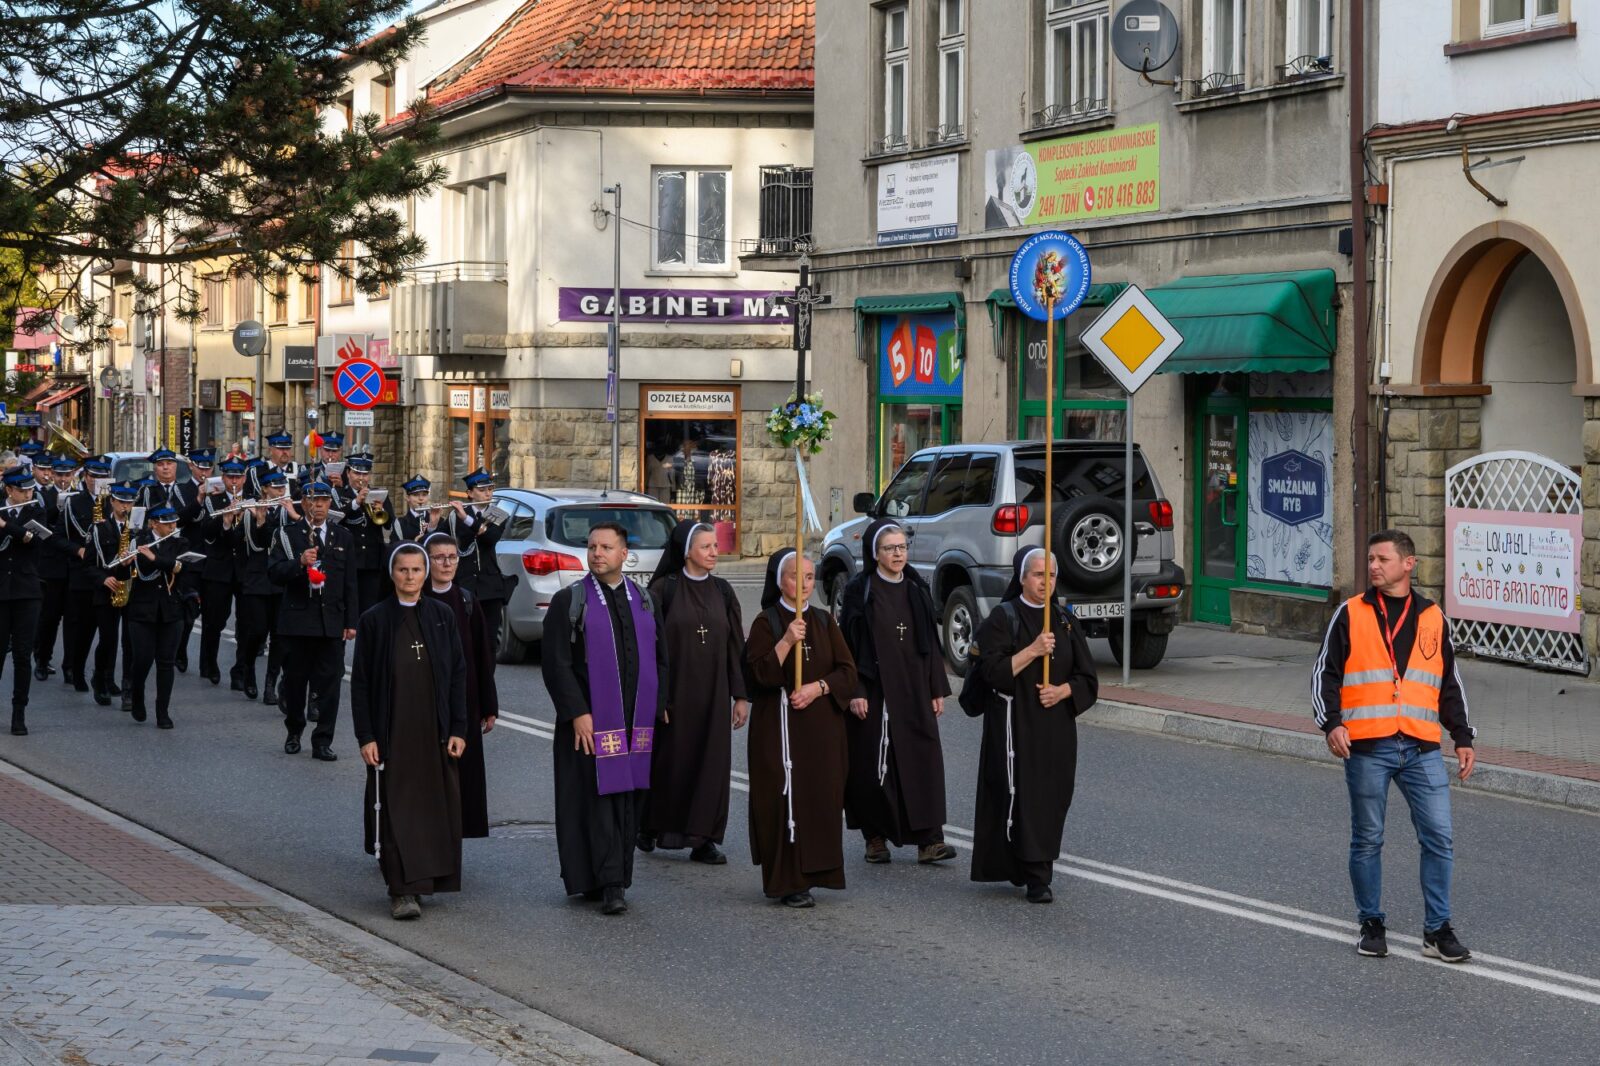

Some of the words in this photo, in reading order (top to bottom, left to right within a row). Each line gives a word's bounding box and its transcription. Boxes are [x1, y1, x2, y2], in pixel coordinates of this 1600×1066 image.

[1039, 141, 1083, 162] KOMPLEKSOWE
[1085, 138, 1107, 156] USŁUGI
[1108, 129, 1156, 152] KOMINIARSKIE
[1054, 163, 1078, 184] Sądecki
[1078, 159, 1099, 178] Zakład
[1100, 155, 1137, 175] Kominiarski
[1038, 196, 1055, 217] 24H
[1060, 192, 1080, 215] 7DNI
[1097, 186, 1113, 210] 518
[1116, 183, 1133, 207] 416
[1136, 179, 1156, 205] 883
[1040, 233, 1067, 242] MSZANY
[1067, 239, 1087, 263] DOLNEJ
[1012, 242, 1034, 290] PIELGRZYMKA
[1083, 263, 1088, 276] DO
[580, 296, 731, 316] GABINET
[1015, 290, 1032, 312] PIESZA
[1062, 277, 1088, 314] LIMANOWEJ
[892, 340, 906, 380] 5
[920, 346, 933, 376] 10
[650, 392, 686, 403] ODZIEŻ
[688, 394, 731, 403] DAMSKA
[1268, 476, 1317, 496] SMAŻALNIA
[1283, 497, 1301, 512] RYB
